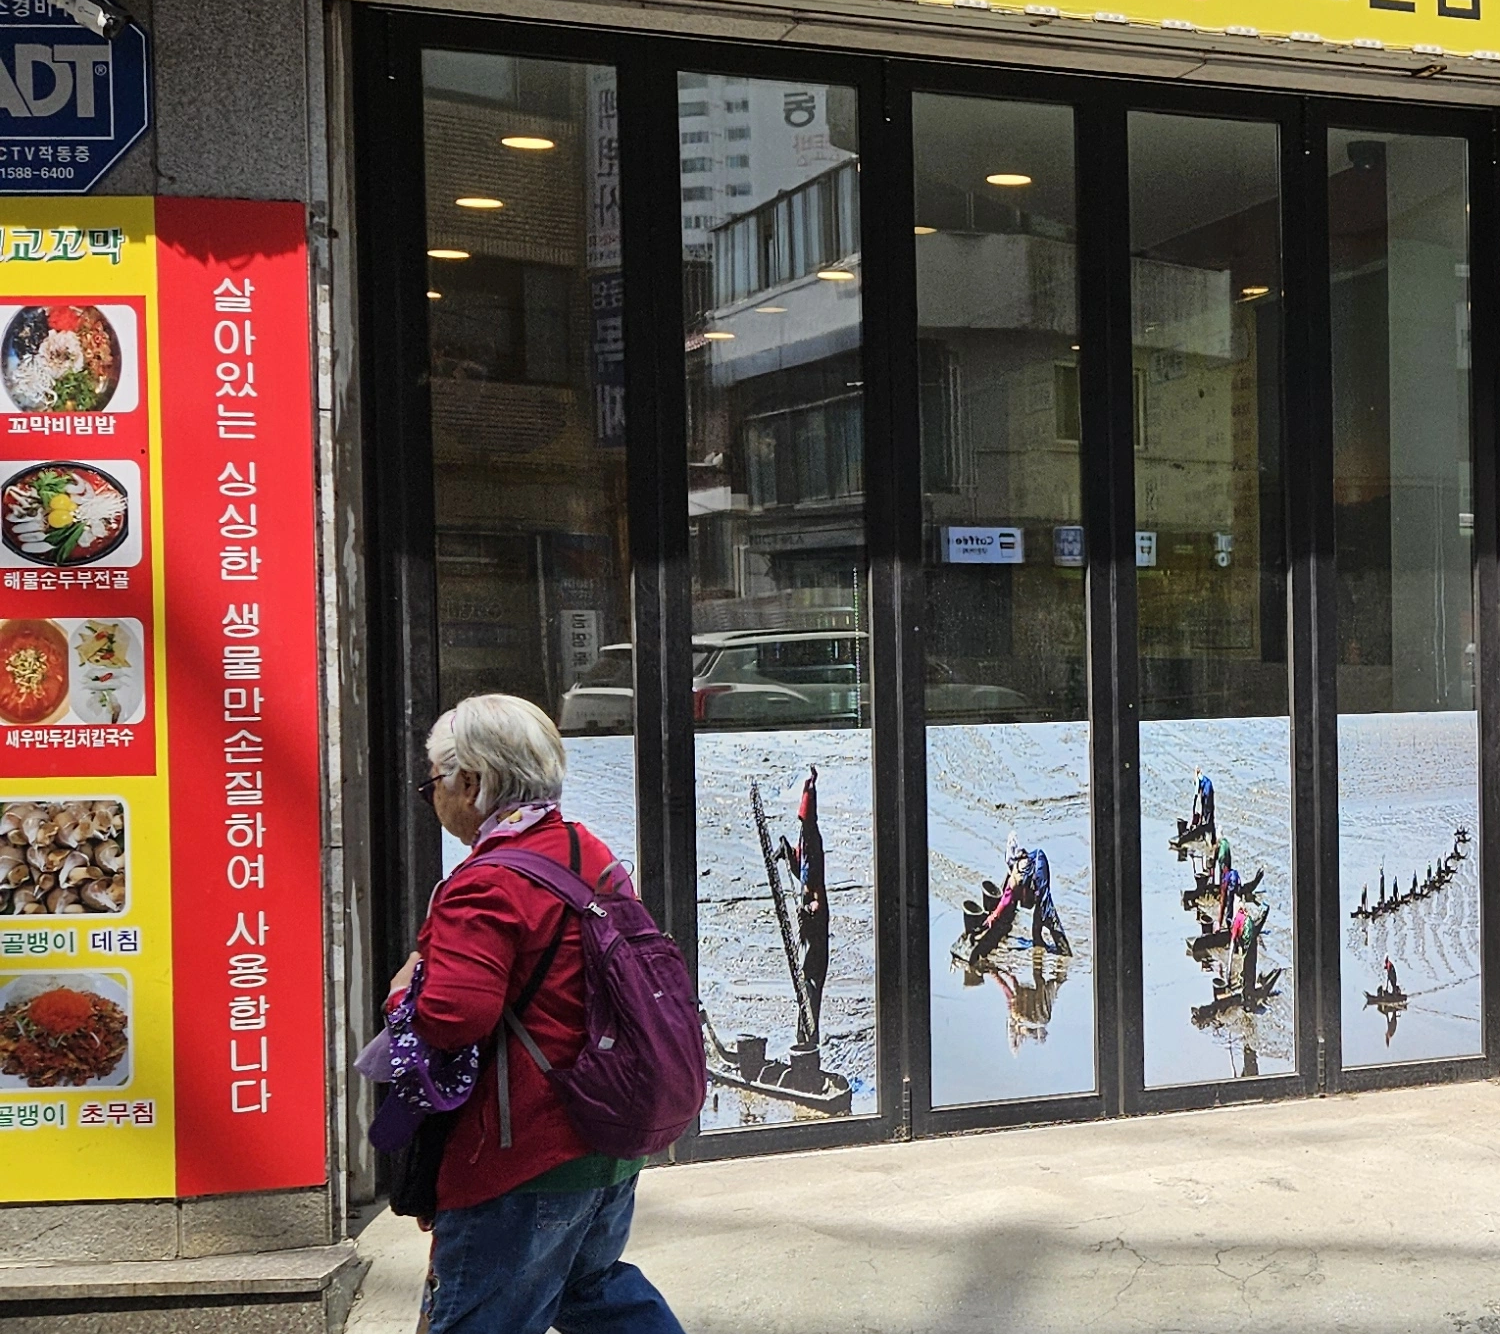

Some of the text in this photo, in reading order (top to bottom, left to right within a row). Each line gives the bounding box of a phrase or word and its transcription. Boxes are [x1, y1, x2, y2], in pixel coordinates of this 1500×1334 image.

[0, 226, 125, 266] 교꼬막
[213, 277, 257, 442] 살아있는
[7, 414, 117, 436] 꼬막비빔밥
[217, 461, 261, 582] 싱싱한
[4, 570, 131, 591] 해물순두부전골
[5, 727, 135, 750] 새우만두김치칼국수
[91, 929, 139, 953] 데침
[225, 910, 272, 1116] 사용합니다
[80, 1101, 154, 1125] 초무침
